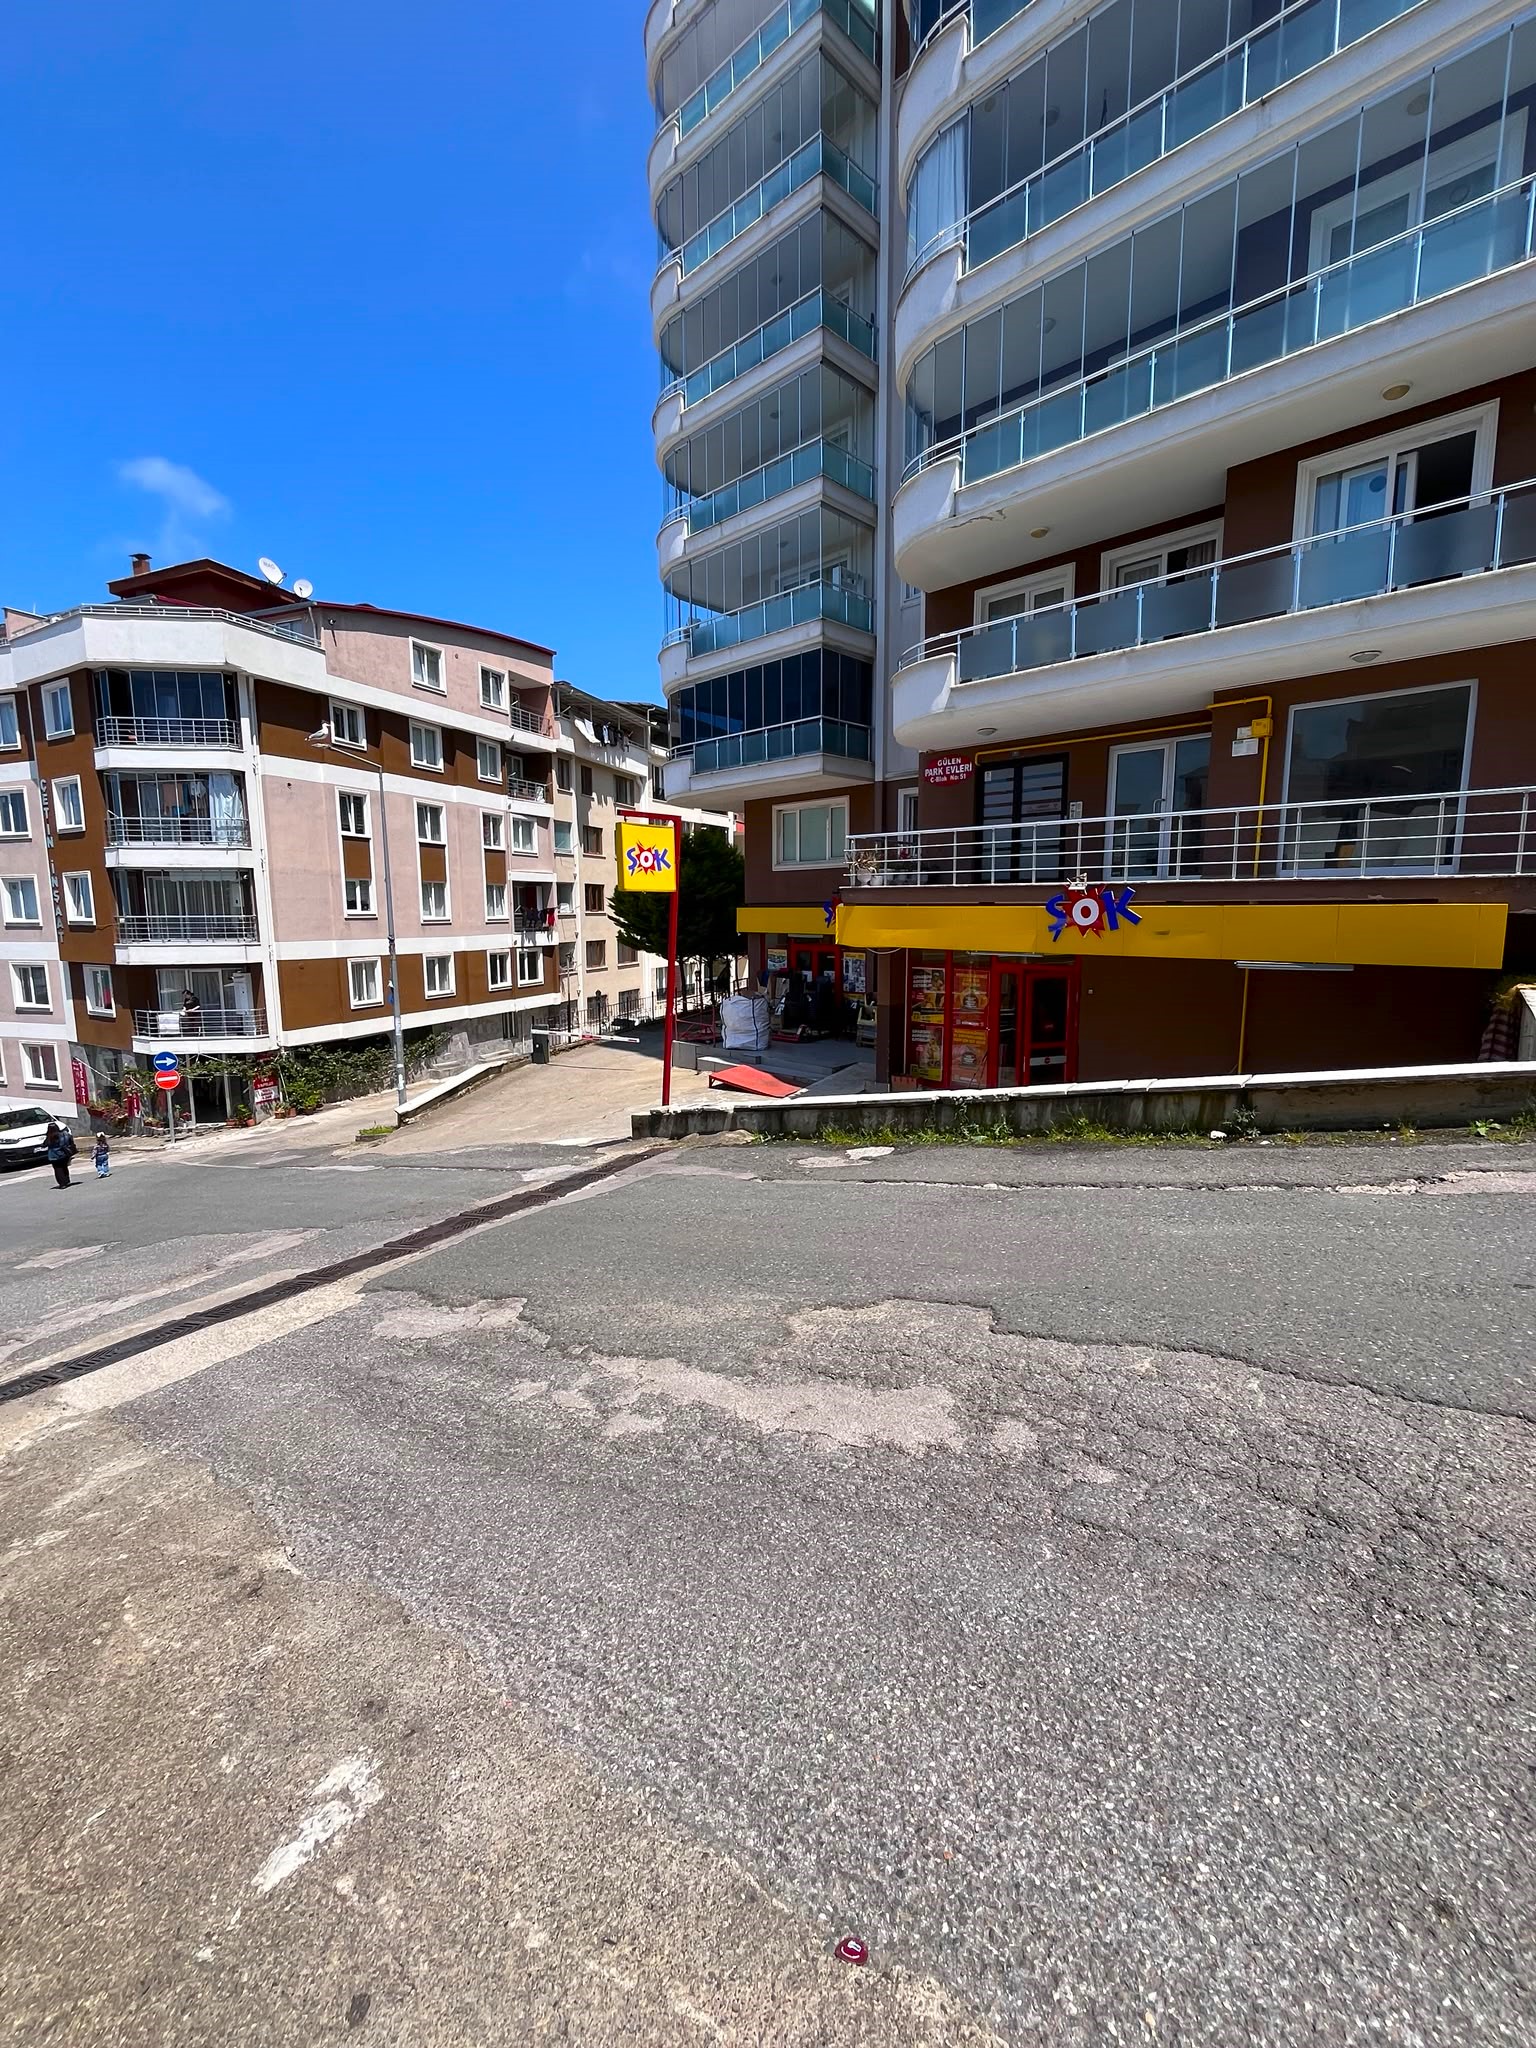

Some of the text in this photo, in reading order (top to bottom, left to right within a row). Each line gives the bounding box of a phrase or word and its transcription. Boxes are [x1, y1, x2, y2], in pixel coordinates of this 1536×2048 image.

[924, 762, 972, 777] PARK EVLERİ
[937, 757, 962, 767] GÜLEN
[627, 847, 672, 877] ŞOK
[1045, 885, 1143, 943] ŞOK
